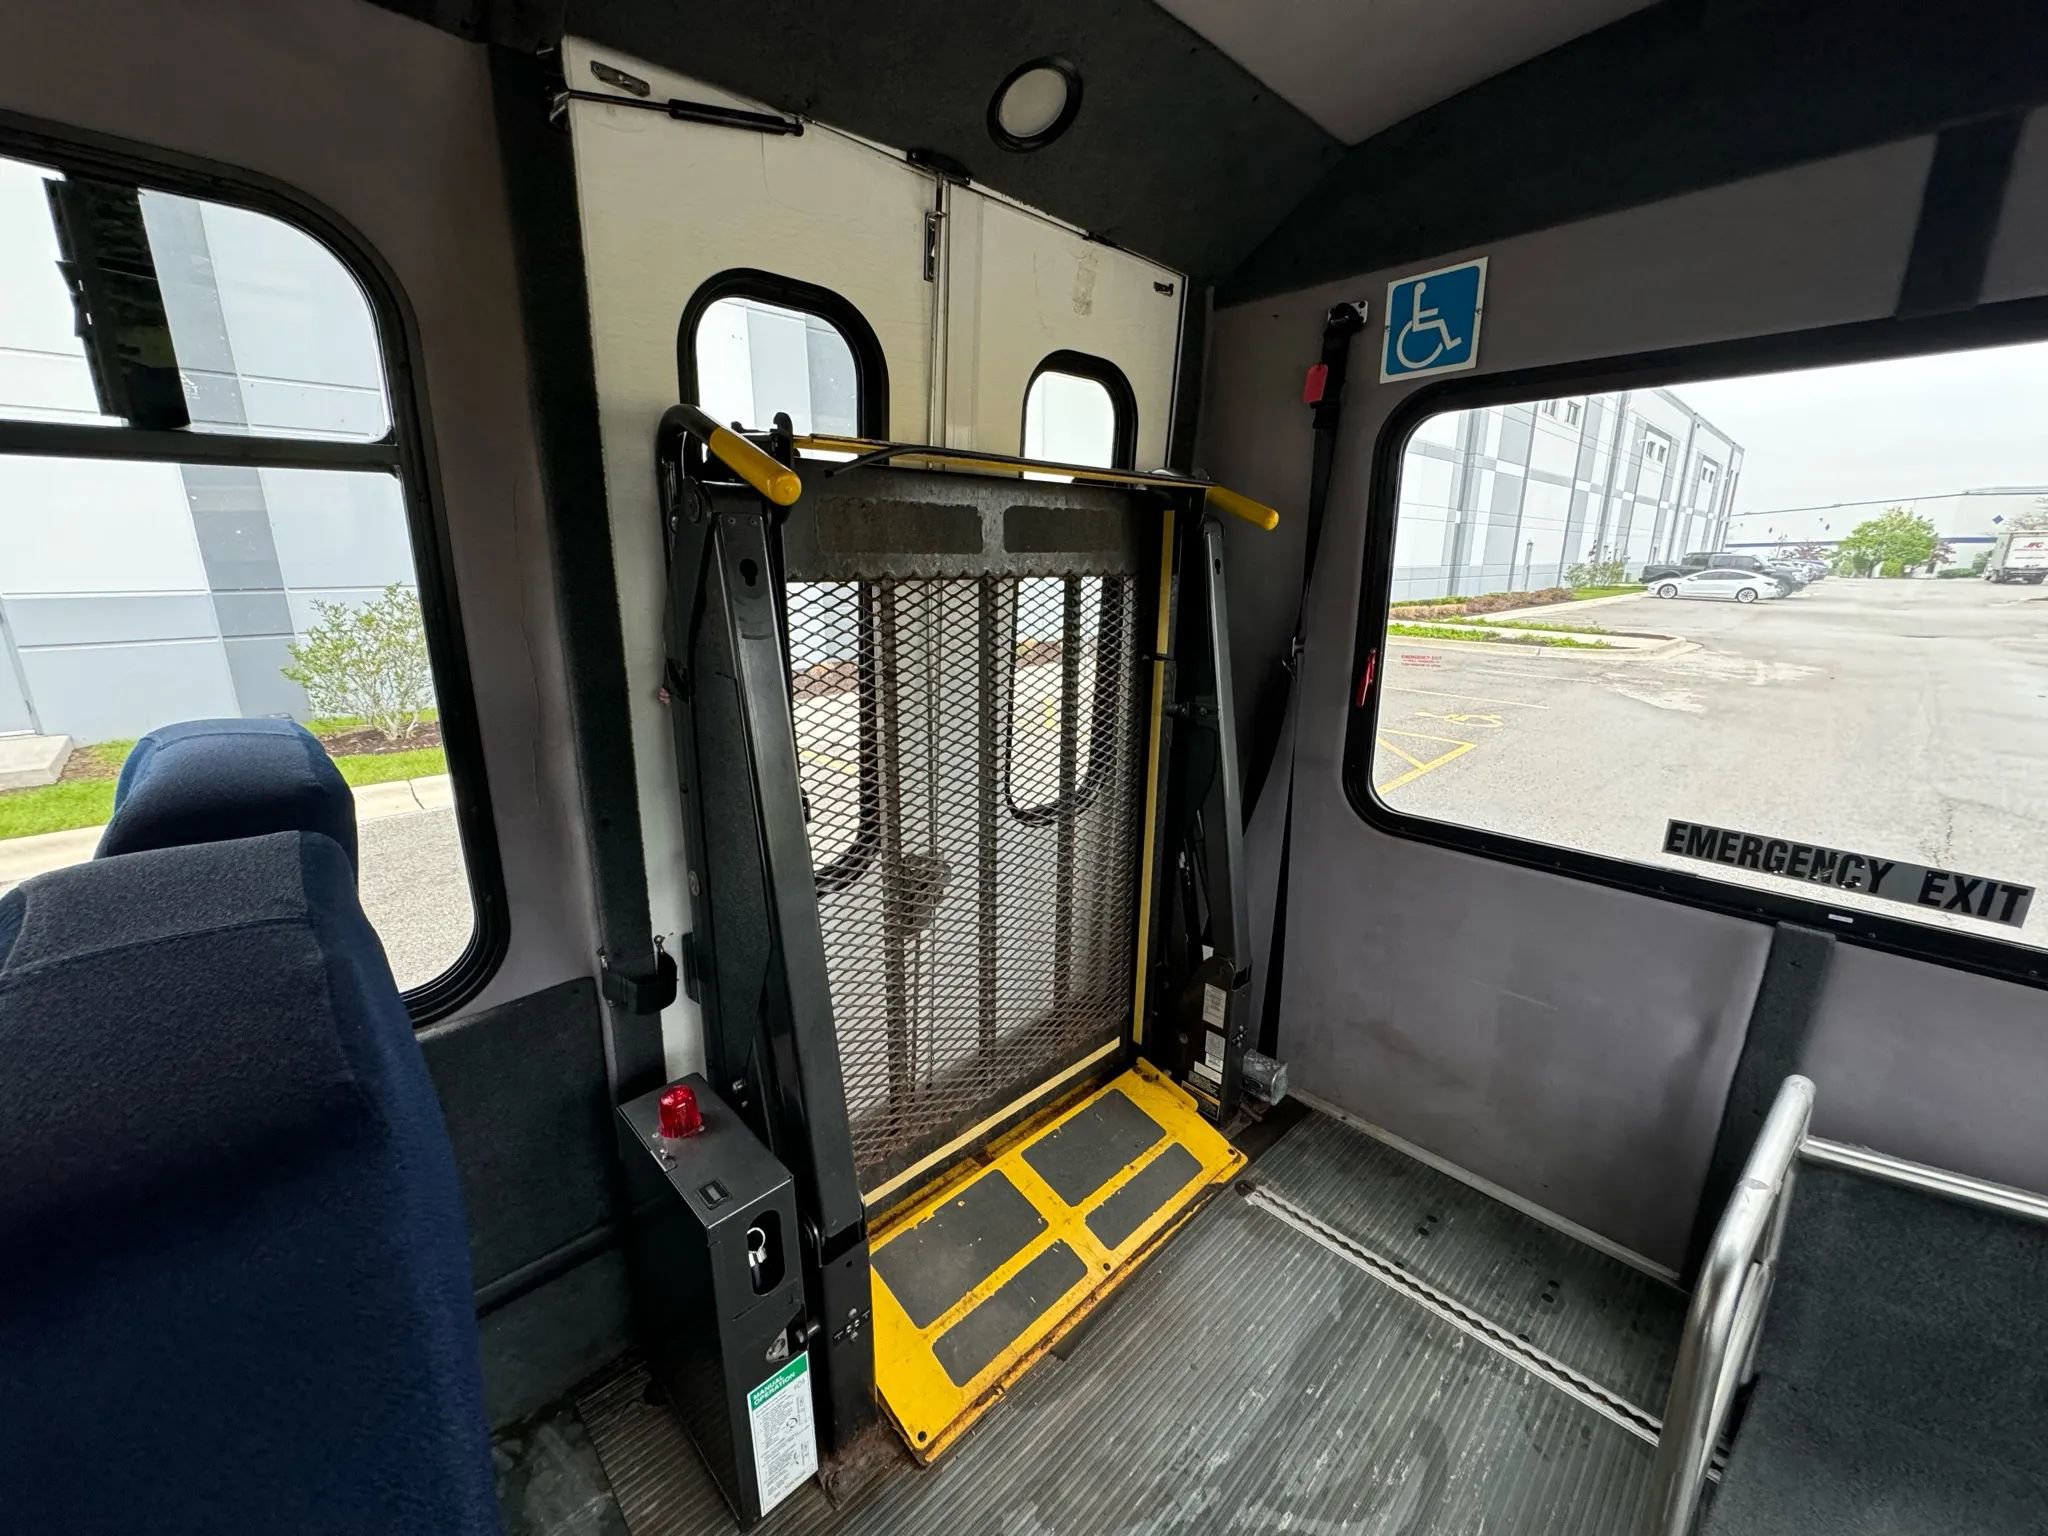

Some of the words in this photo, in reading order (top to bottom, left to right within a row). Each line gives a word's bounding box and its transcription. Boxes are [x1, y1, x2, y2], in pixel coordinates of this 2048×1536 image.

[1667, 822, 1895, 894] EMERGENCY
[1917, 871, 2029, 923] EXIT
[753, 1375, 785, 1400] MANUAL
[754, 1371, 796, 1406] OPERATION
